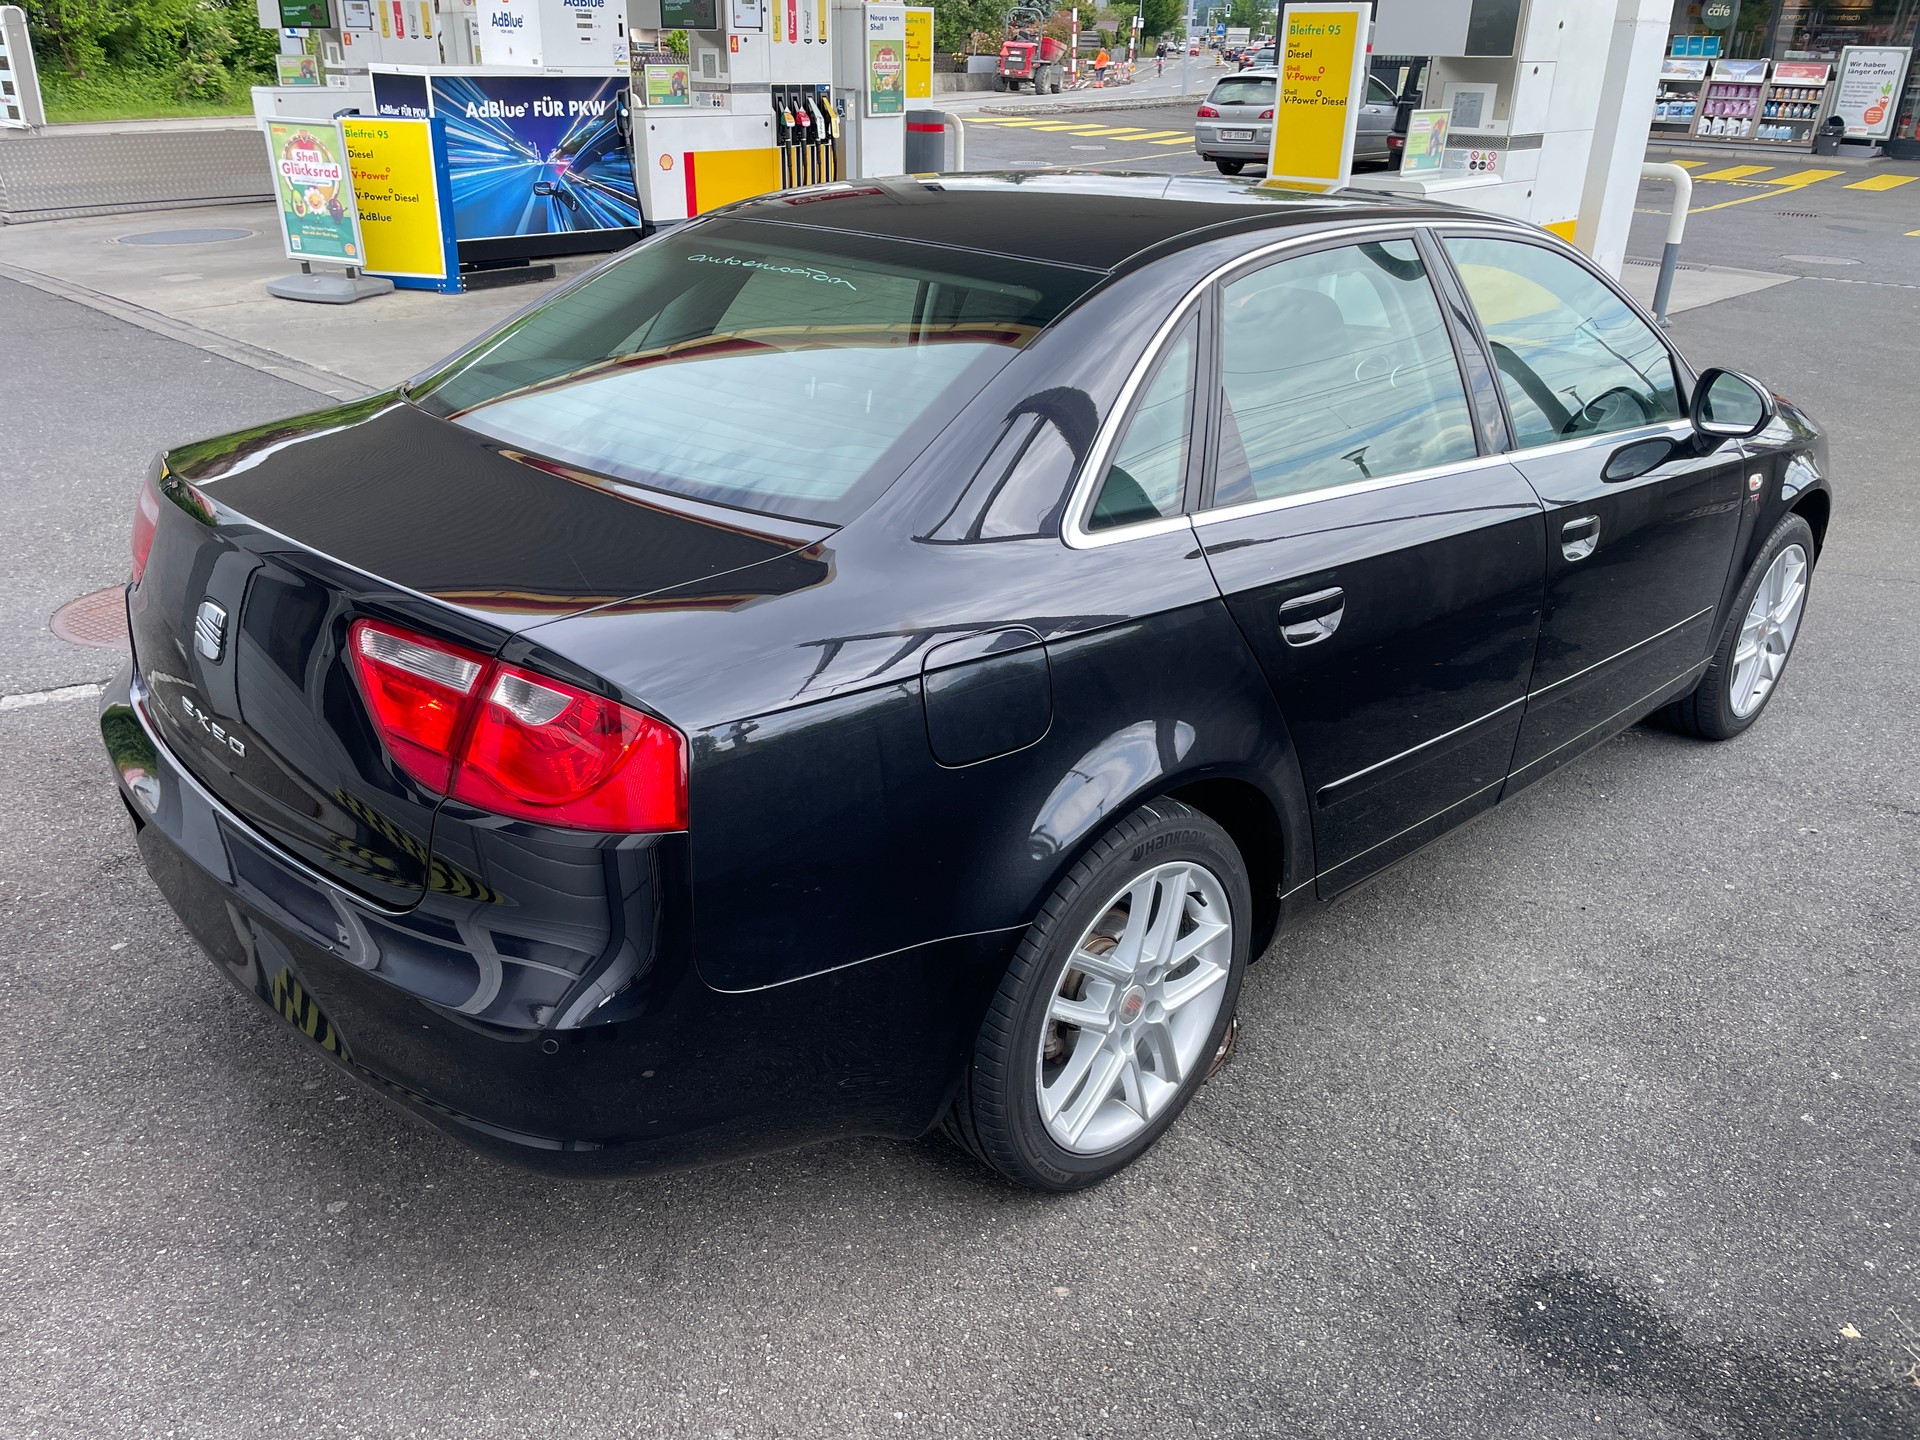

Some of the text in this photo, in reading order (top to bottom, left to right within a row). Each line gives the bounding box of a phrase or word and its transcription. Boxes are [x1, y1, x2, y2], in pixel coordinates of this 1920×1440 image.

[1707, 5, 1731, 17] café
[870, 14, 888, 22] Neues
[870, 23, 884, 31] Shell
[1290, 24, 1342, 35] Bleifrei 95
[345, 33, 351, 45] 2
[731, 36, 738, 51] 4
[1287, 49, 1313, 58] Diesel
[873, 62, 901, 70] Glücksrad
[1286, 72, 1322, 82] V-Power
[1847, 68, 1871, 76] länger
[533, 96, 566, 117] FÜR
[569, 100, 606, 117] PKW
[1283, 96, 1348, 106] V-Power Diesel
[400, 104, 412, 117] FÜR
[412, 107, 427, 118] PKW
[345, 129, 389, 139] Bleifrei 95
[296, 151, 320, 163] Shell
[347, 149, 374, 158] Diesel
[282, 162, 340, 179] Glücksrad
[351, 171, 389, 181] V-Power
[354, 191, 420, 203] V-Power Diesel
[358, 212, 392, 223] AdBlue
[182, 695, 247, 758] EXEO
